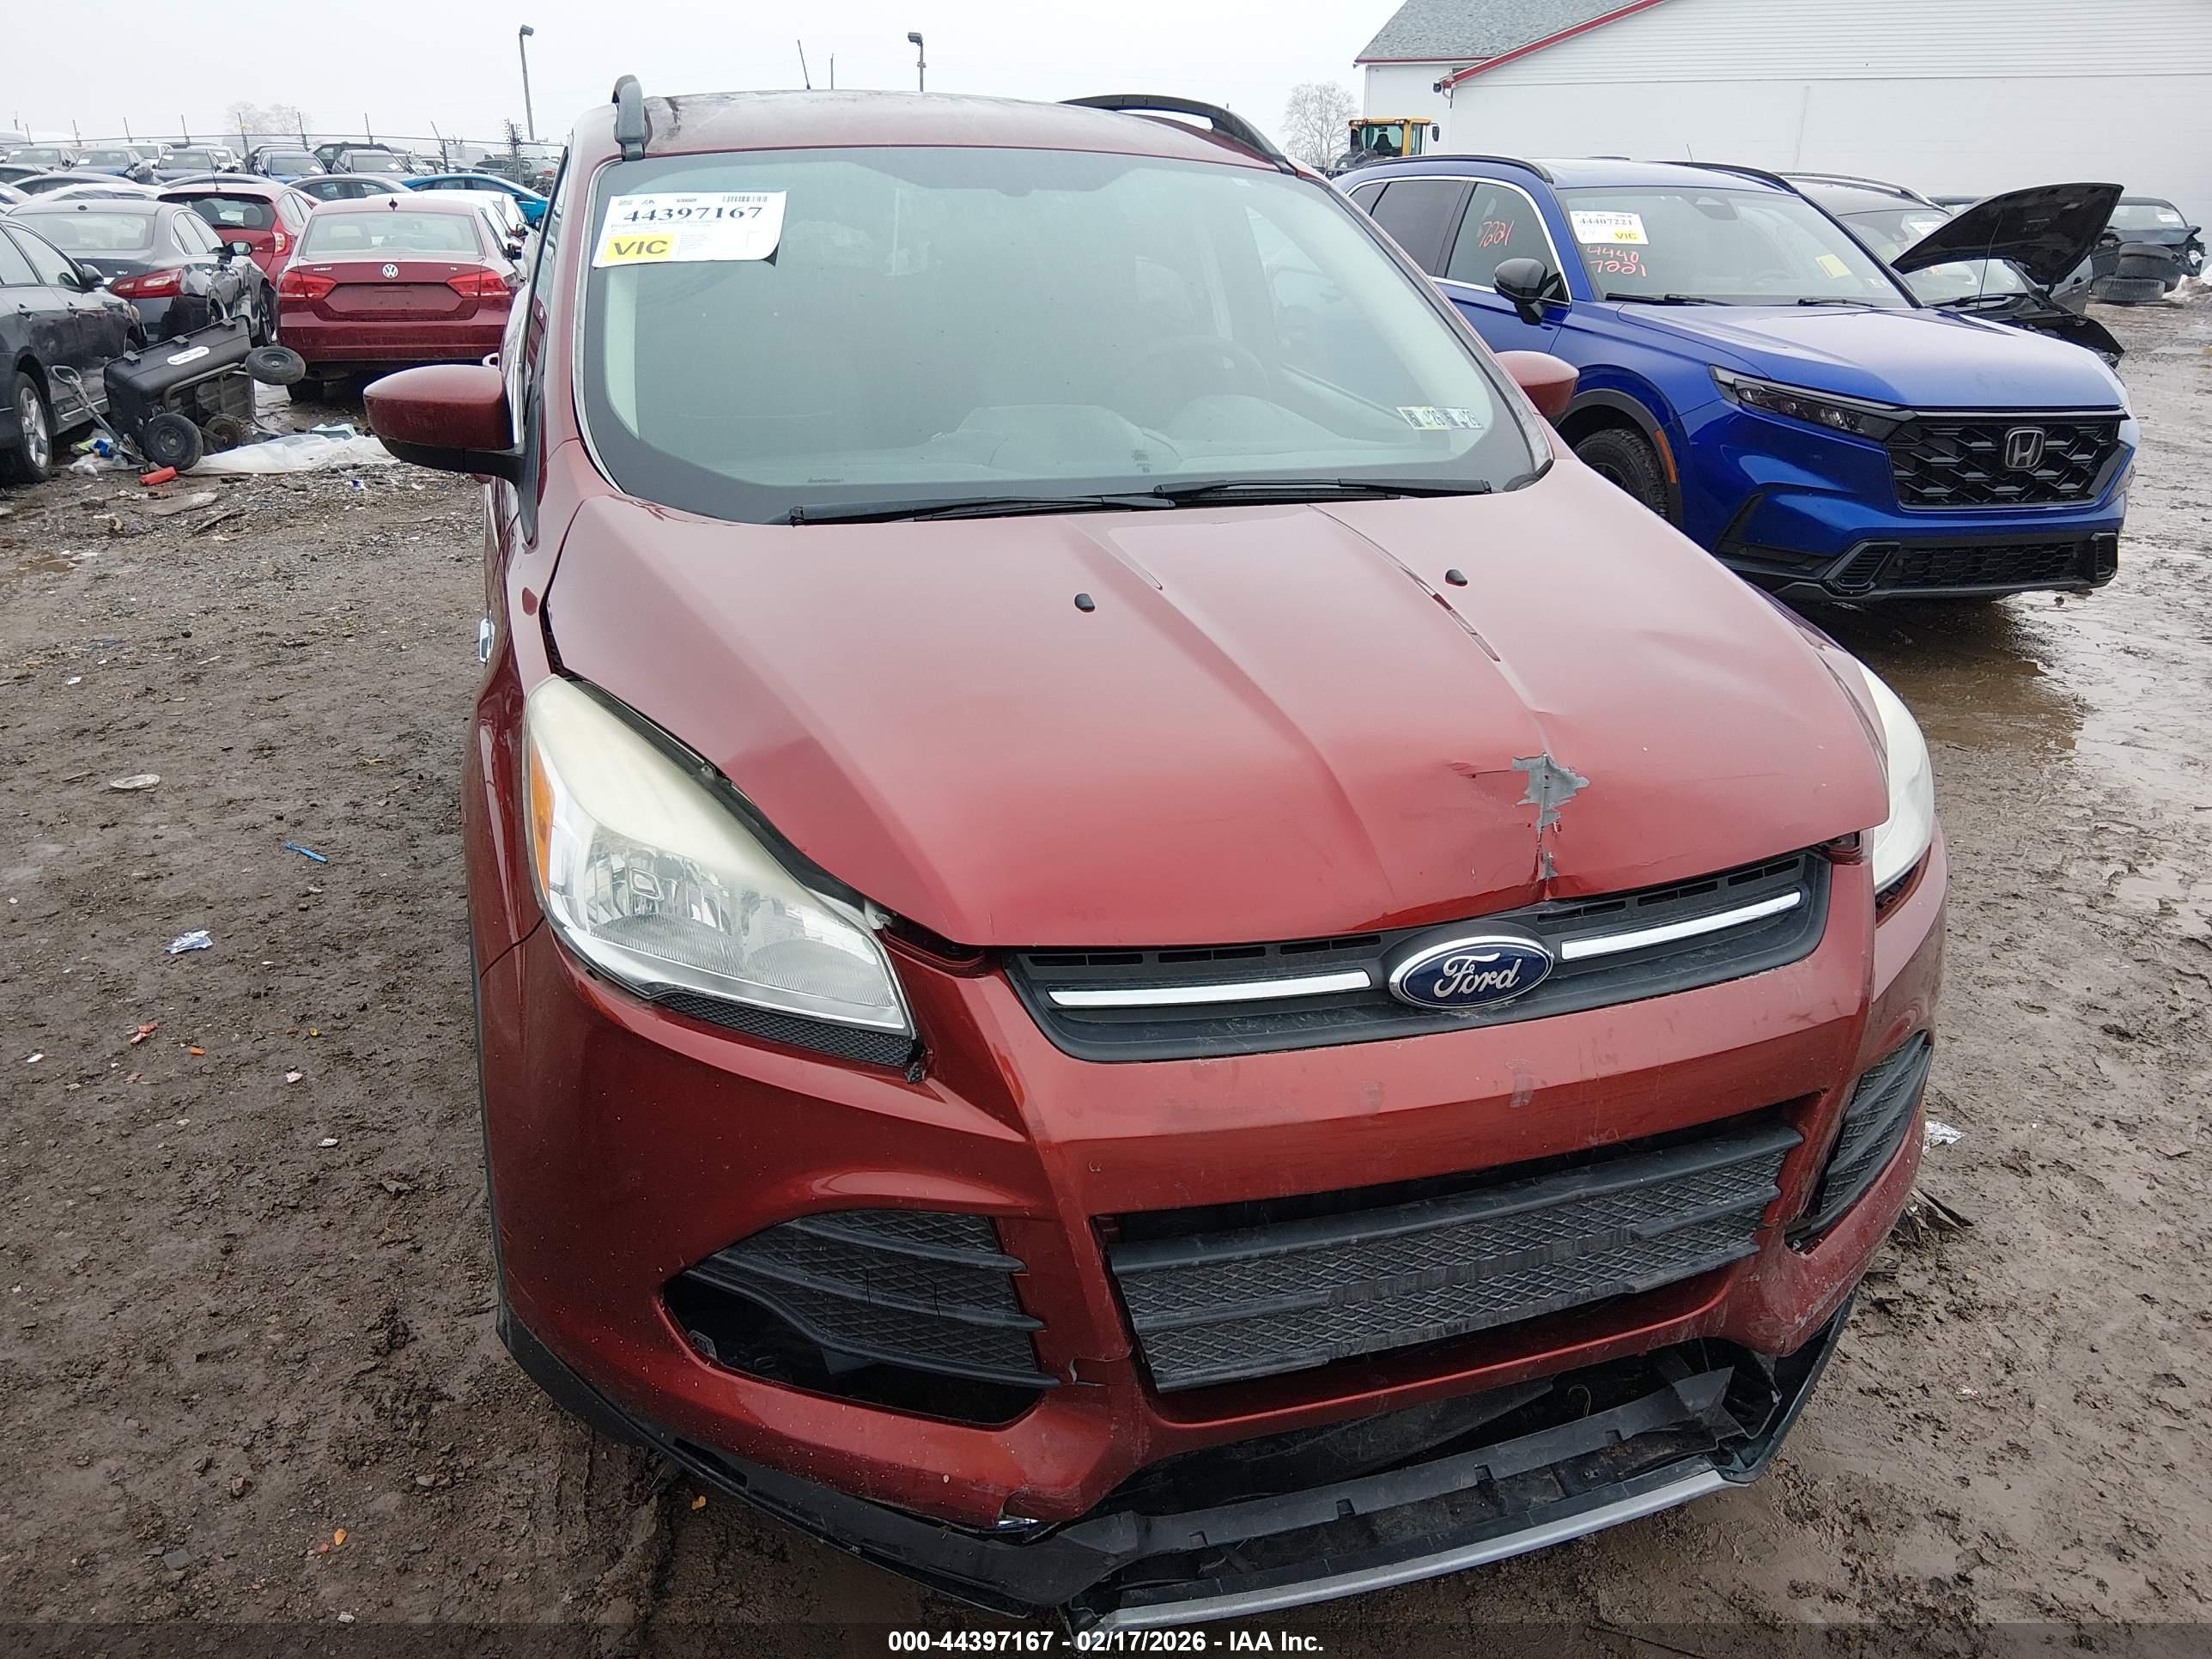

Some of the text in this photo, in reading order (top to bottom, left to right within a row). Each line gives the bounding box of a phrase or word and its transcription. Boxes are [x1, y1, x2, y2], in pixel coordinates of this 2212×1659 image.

[623, 207, 763, 222] 44397167
[1479, 220, 1515, 247] 7221
[614, 240, 668, 256] VIC
[1589, 260, 1647, 277] 7221
[1433, 952, 1522, 998] Ford
